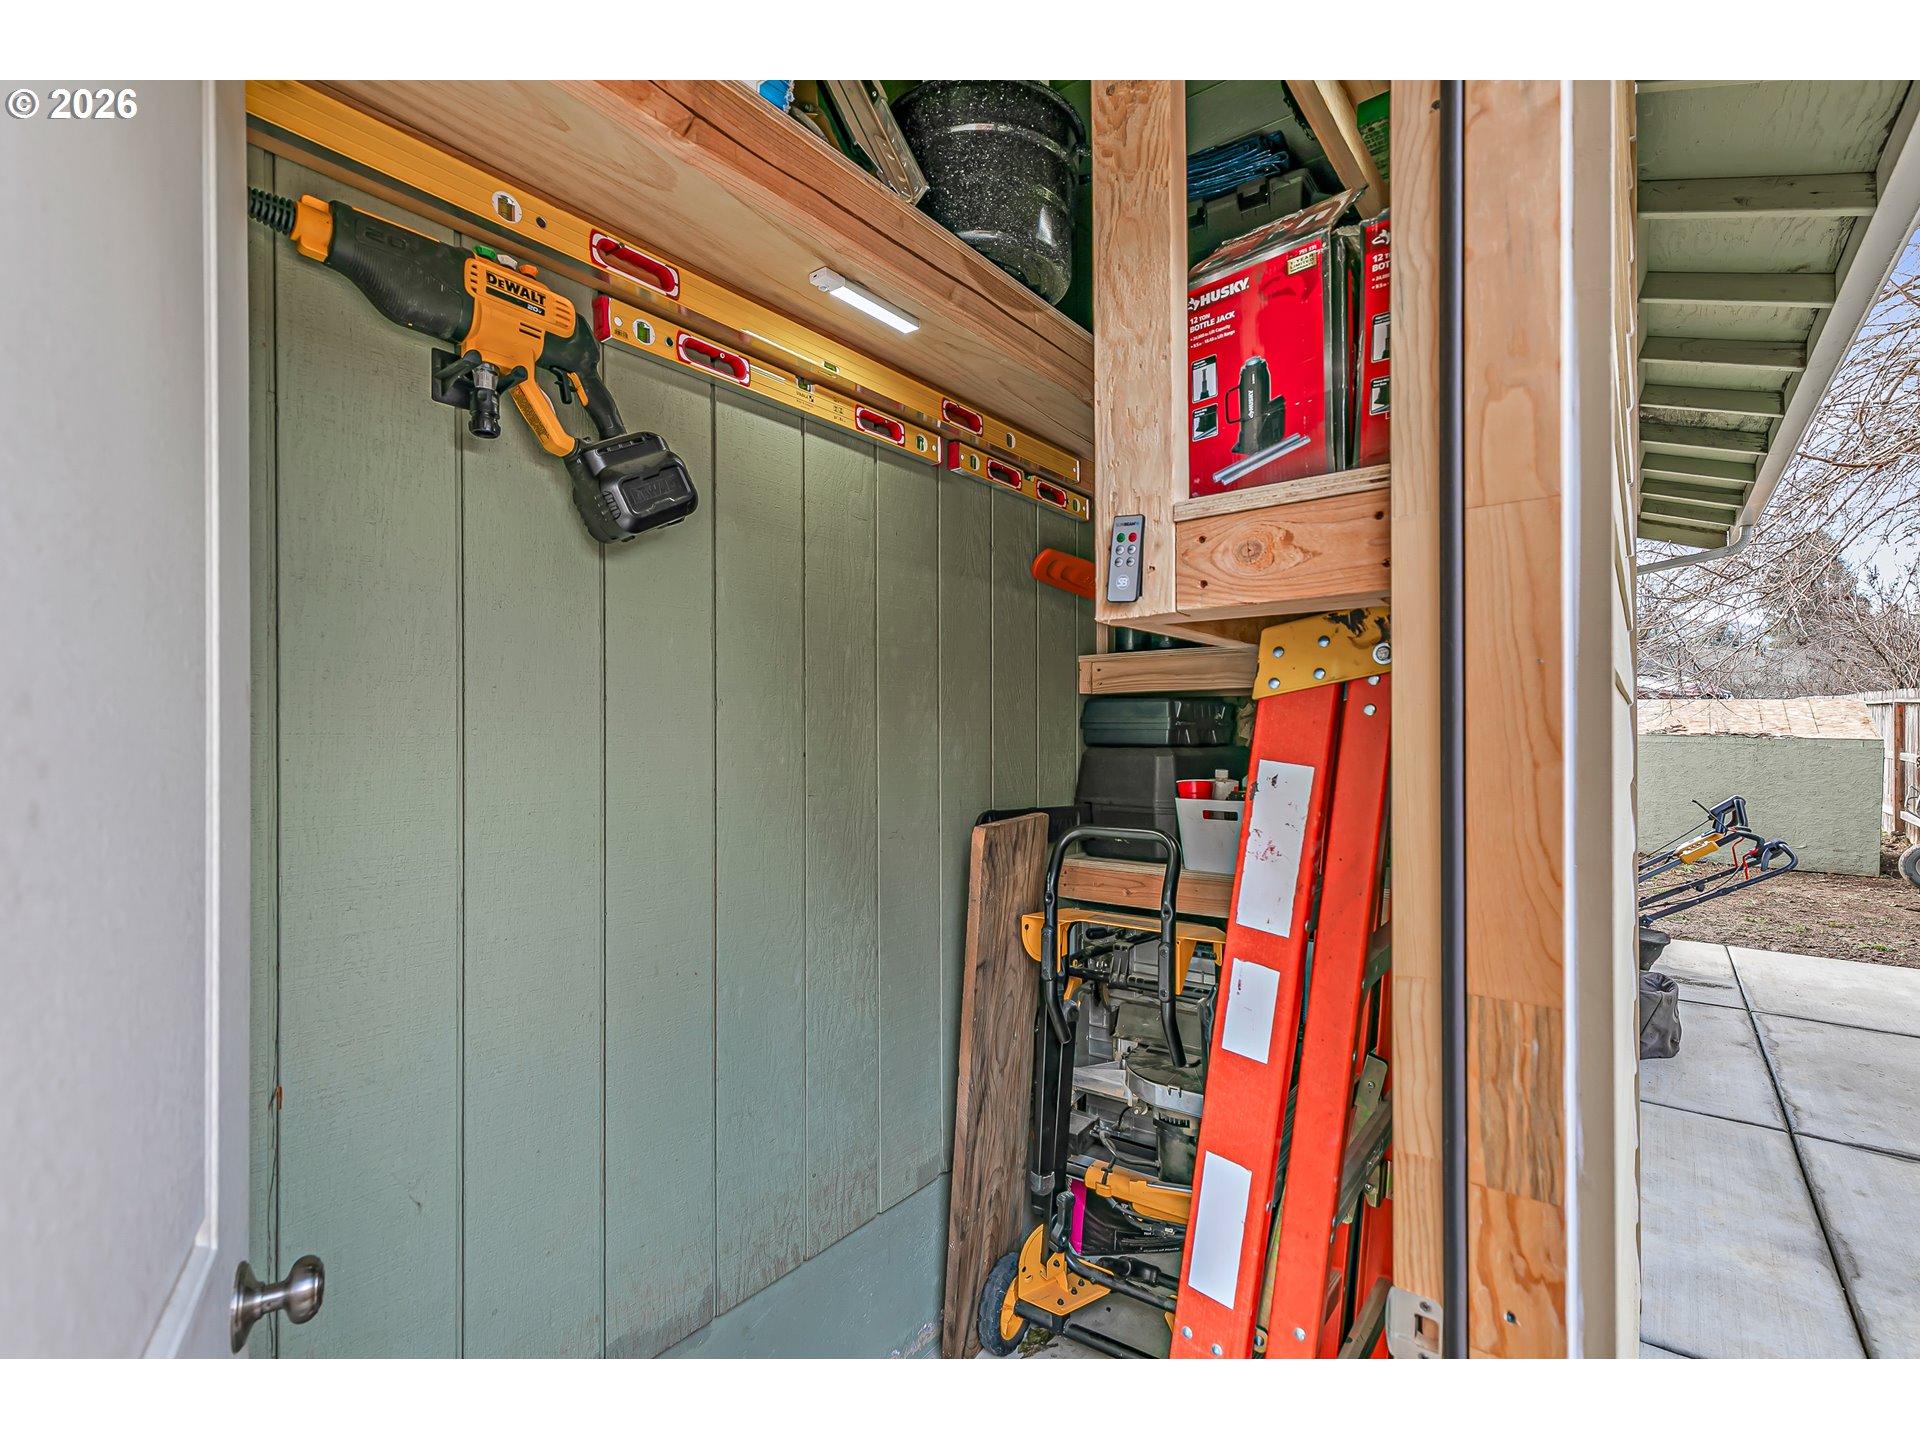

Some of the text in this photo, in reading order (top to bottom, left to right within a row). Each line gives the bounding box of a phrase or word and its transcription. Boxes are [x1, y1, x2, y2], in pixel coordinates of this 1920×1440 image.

[1371, 260, 1391, 273] BOT
[1372, 253, 1384, 263] 12
[1200, 276, 1250, 307] HUSKY
[1189, 313, 1211, 325] 12 TON
[1189, 310, 1236, 334] BOTTLE JACK
[1247, 389, 1255, 411] HUSKY
